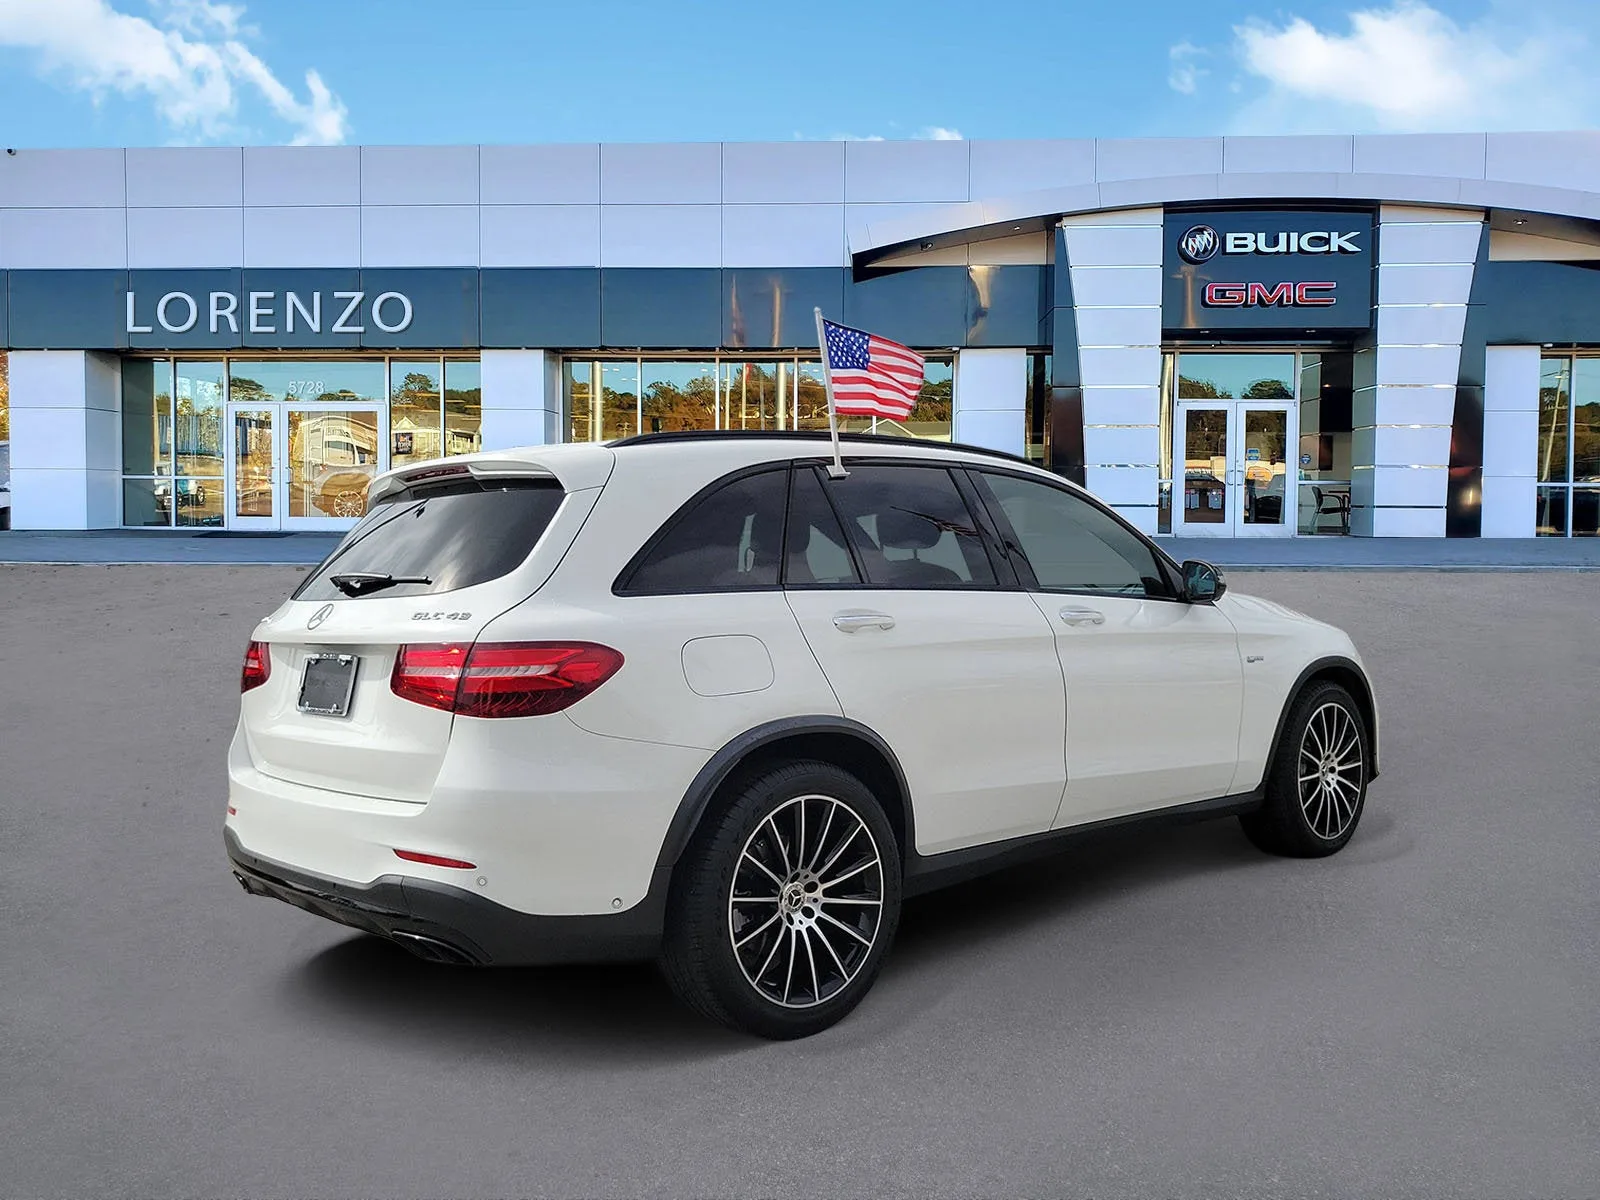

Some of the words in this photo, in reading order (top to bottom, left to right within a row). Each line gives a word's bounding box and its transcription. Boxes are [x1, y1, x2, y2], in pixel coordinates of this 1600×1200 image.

[1225, 231, 1362, 253] BUICK
[1206, 281, 1337, 305] GMC
[126, 291, 414, 333] LORENZO
[288, 380, 325, 394] 5728
[411, 612, 445, 621] GLC
